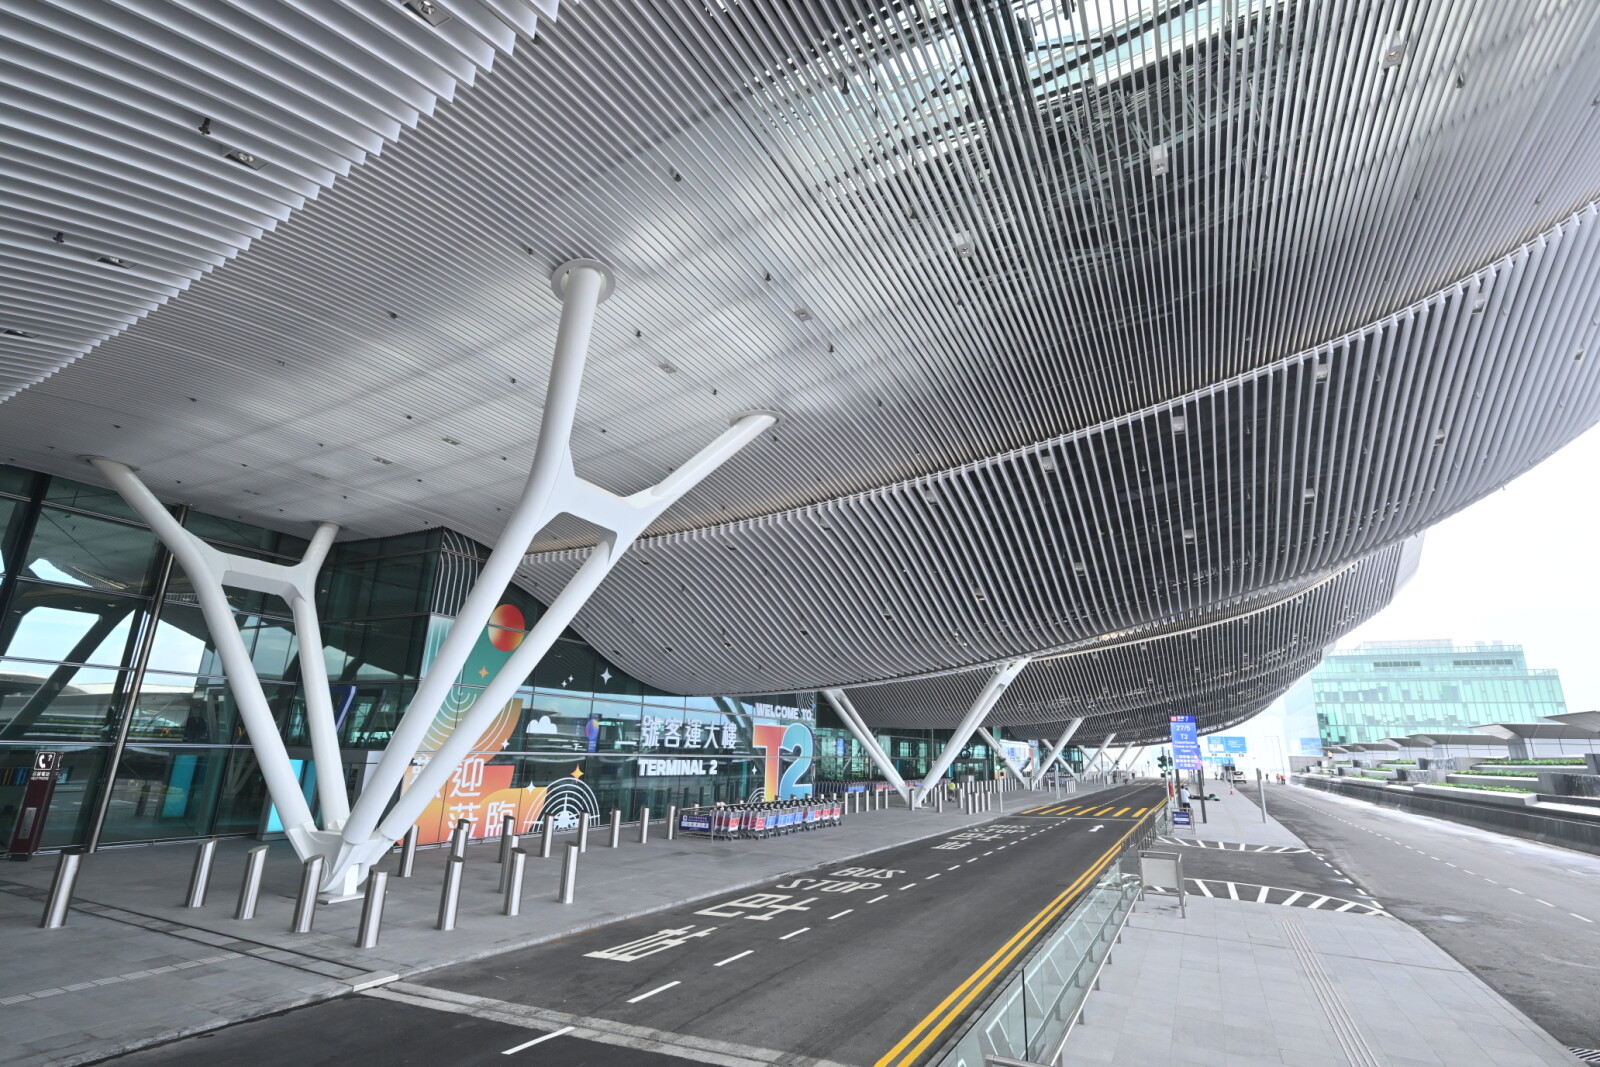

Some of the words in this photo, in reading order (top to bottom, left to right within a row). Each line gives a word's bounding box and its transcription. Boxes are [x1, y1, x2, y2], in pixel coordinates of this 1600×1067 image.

[754, 702, 799, 719] WELCOME
[802, 709, 812, 721] TO
[614, 713, 738, 749] 二號客運大樓
[638, 758, 706, 776] TERMINAL
[709, 759, 718, 775] 2
[752, 723, 814, 802] T2
[947, 833, 1003, 842] 巴士
[829, 867, 905, 878] BUS
[776, 878, 882, 893] STOP
[694, 893, 818, 921] 巴士
[582, 925, 718, 962] 站
